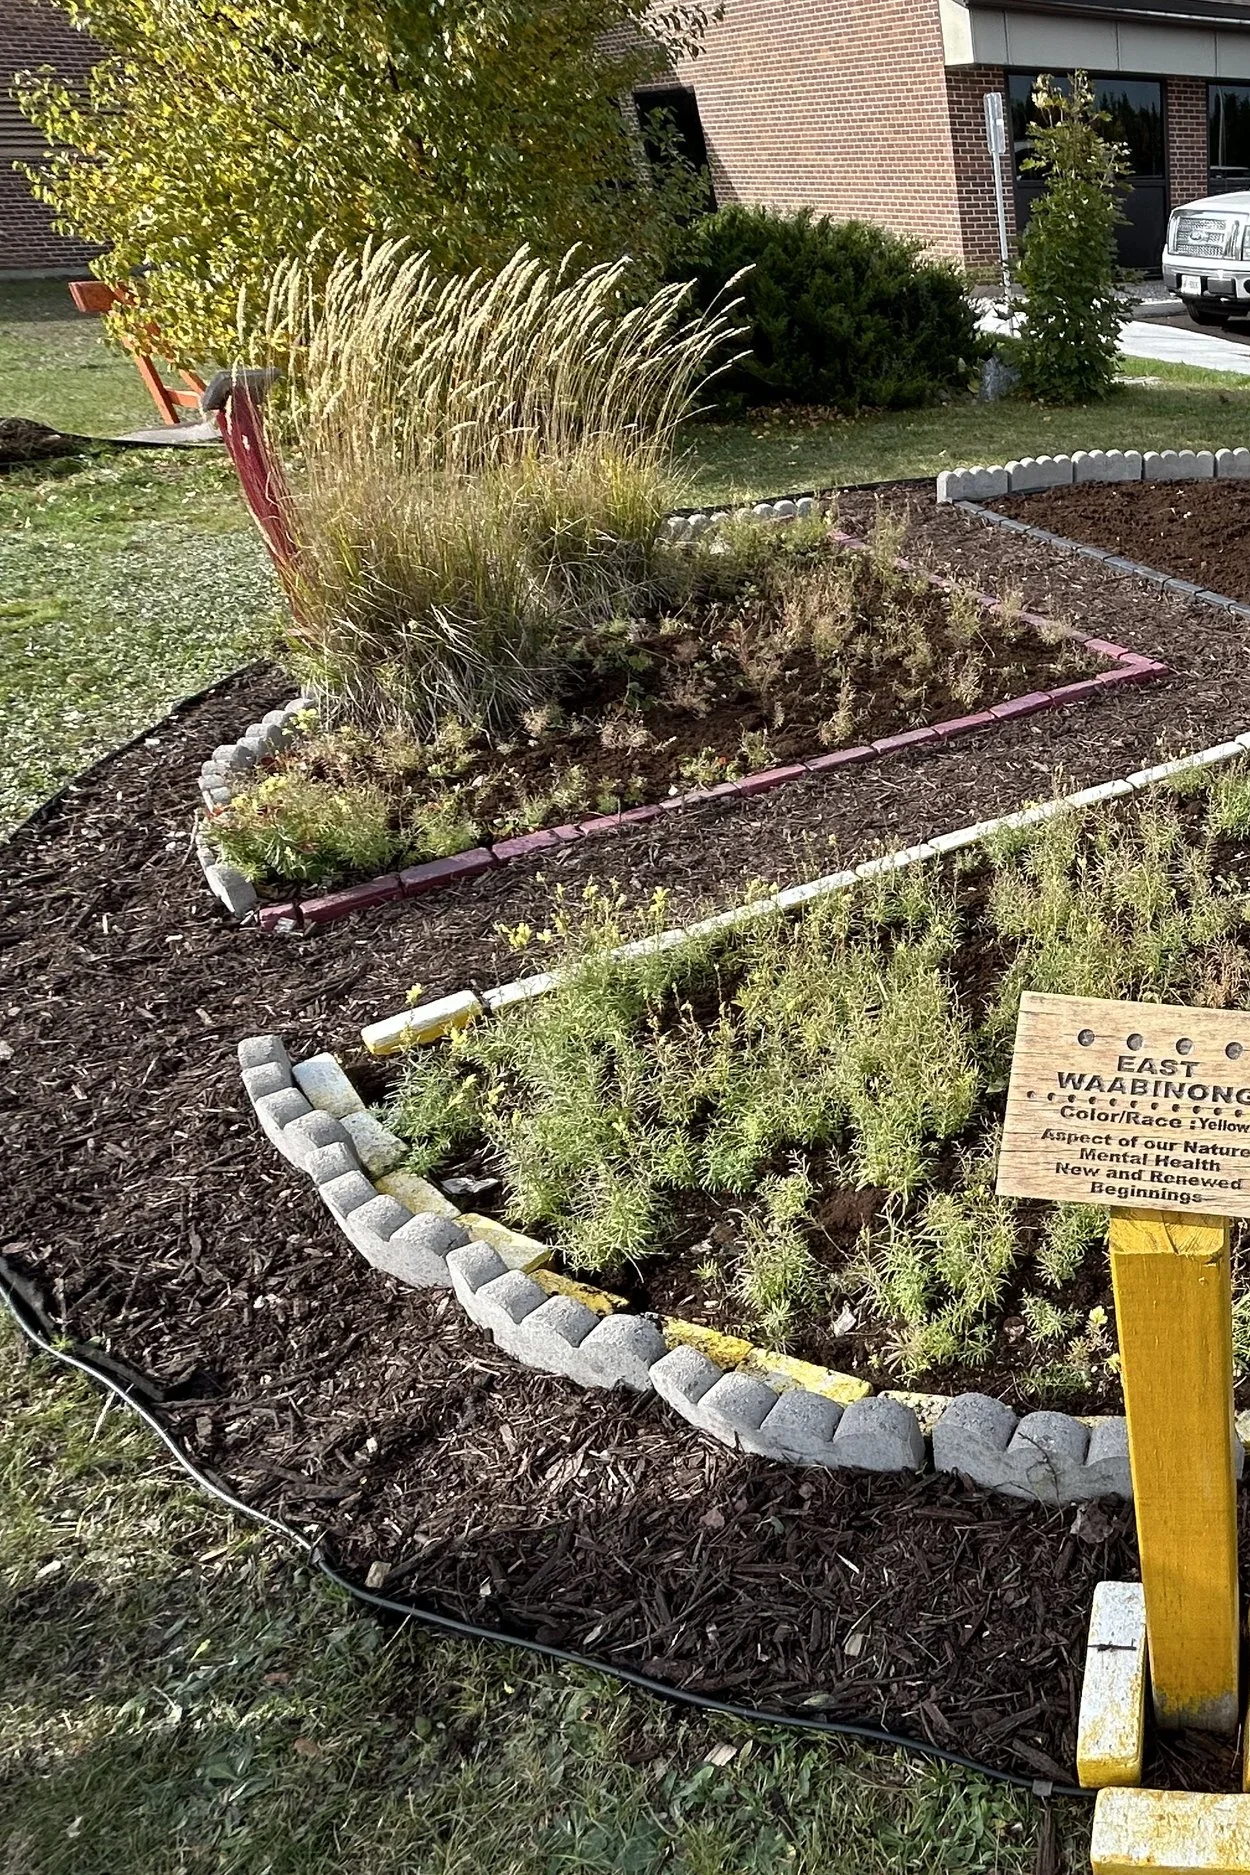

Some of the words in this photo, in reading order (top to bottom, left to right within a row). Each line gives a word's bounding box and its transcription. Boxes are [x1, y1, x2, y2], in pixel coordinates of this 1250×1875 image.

[1117, 1055, 1200, 1077] EAST
[1060, 1105, 1182, 1128] Color/Race
[1041, 1128, 1112, 1145] Aspect
[1118, 1136, 1139, 1148] of
[1144, 1140, 1178, 1151] our
[1080, 1148, 1148, 1165] Mental
[1155, 1154, 1220, 1172] Health
[1056, 1162, 1100, 1177] New
[1106, 1169, 1143, 1181] and
[1150, 1171, 1242, 1190] Renewed
[1091, 1182, 1203, 1204] Beginnings
